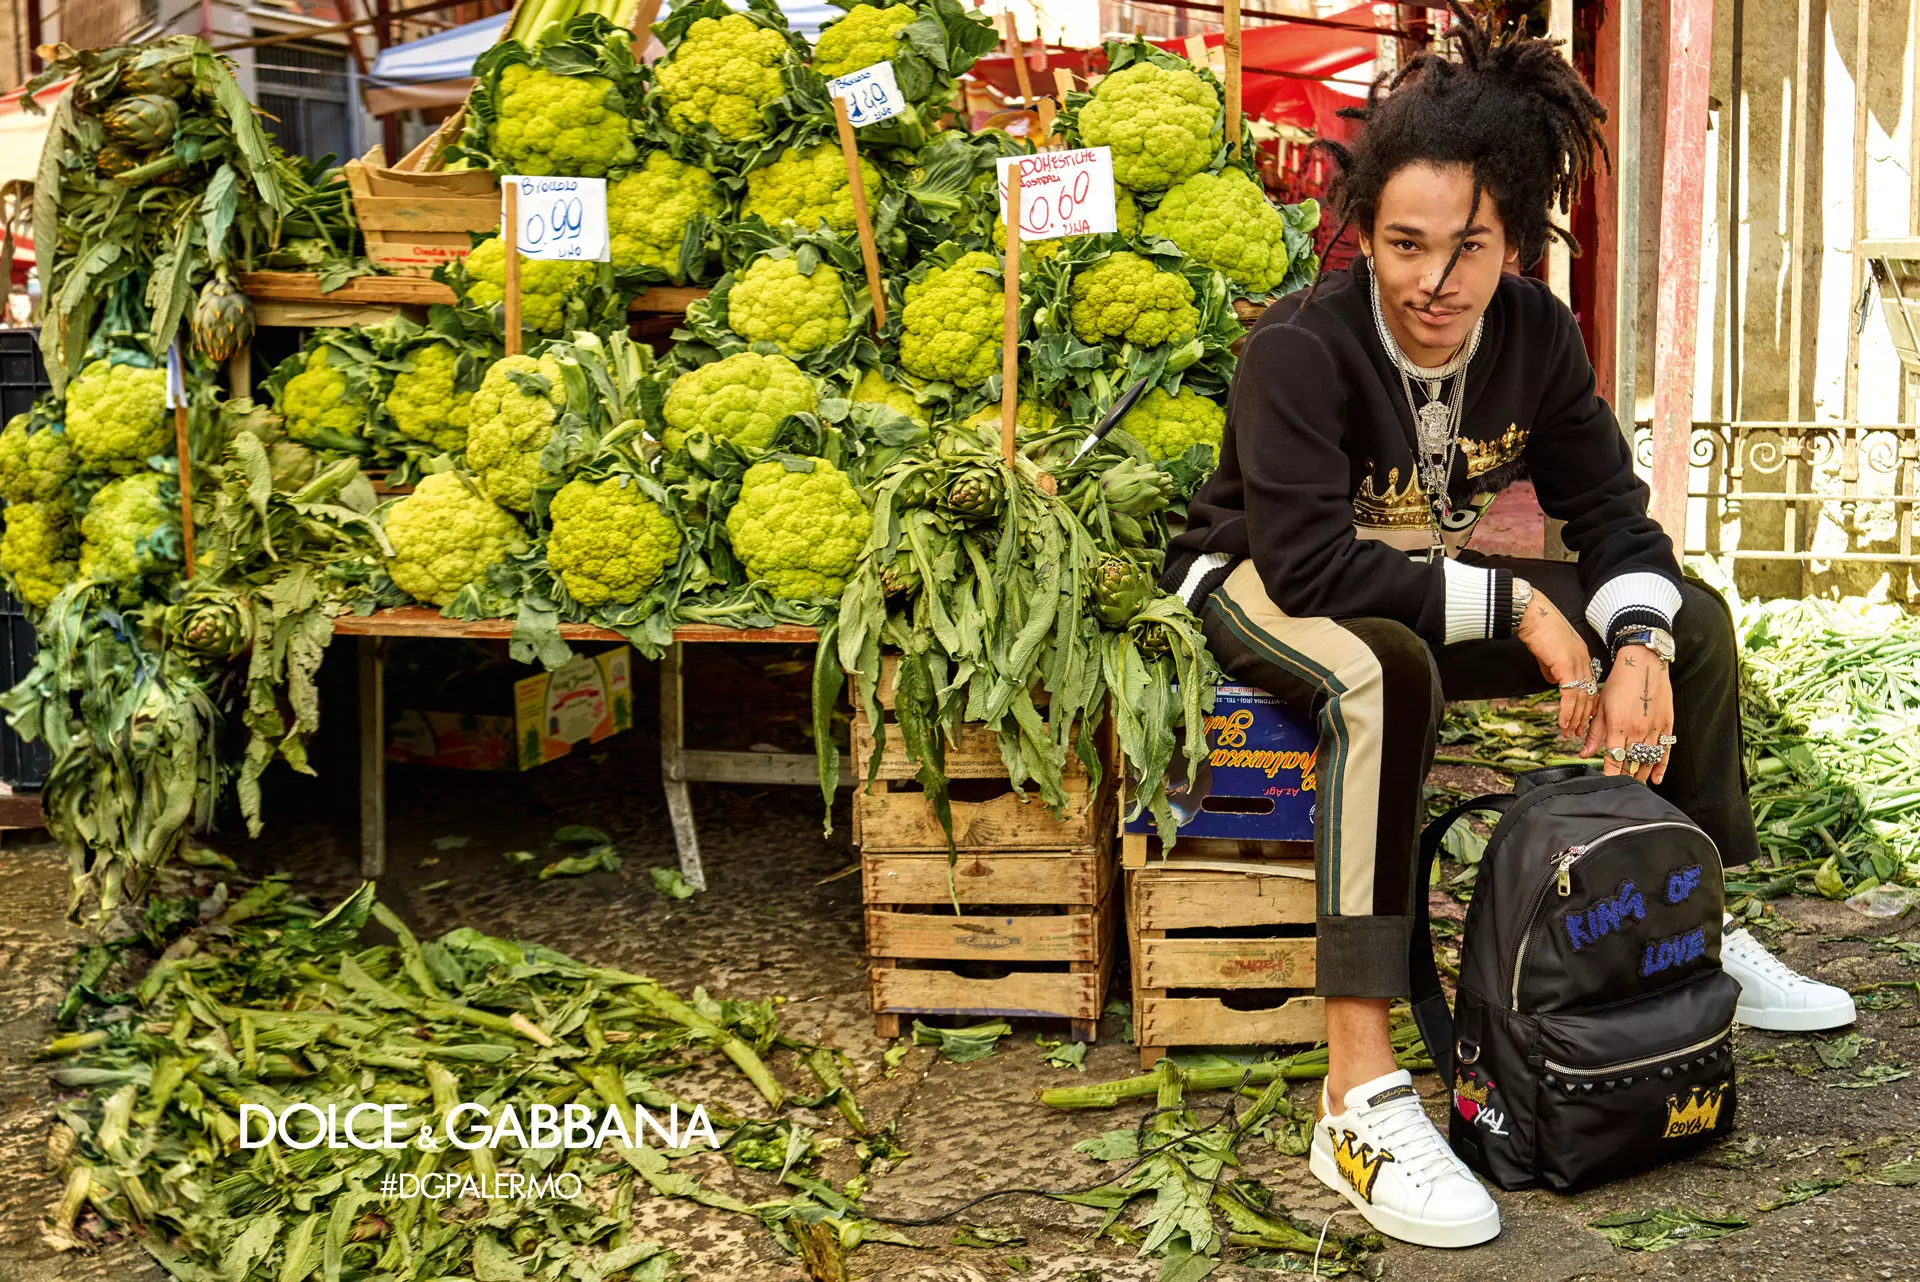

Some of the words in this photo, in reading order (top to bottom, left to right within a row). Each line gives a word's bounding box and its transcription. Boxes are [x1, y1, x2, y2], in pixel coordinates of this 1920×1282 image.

[1019, 150, 1097, 178] DOMESTICHE
[1063, 219, 1090, 236] UNA
[1565, 882, 1647, 950] KING
[1667, 866, 1702, 904] OF
[1643, 928, 1705, 976] LOVE
